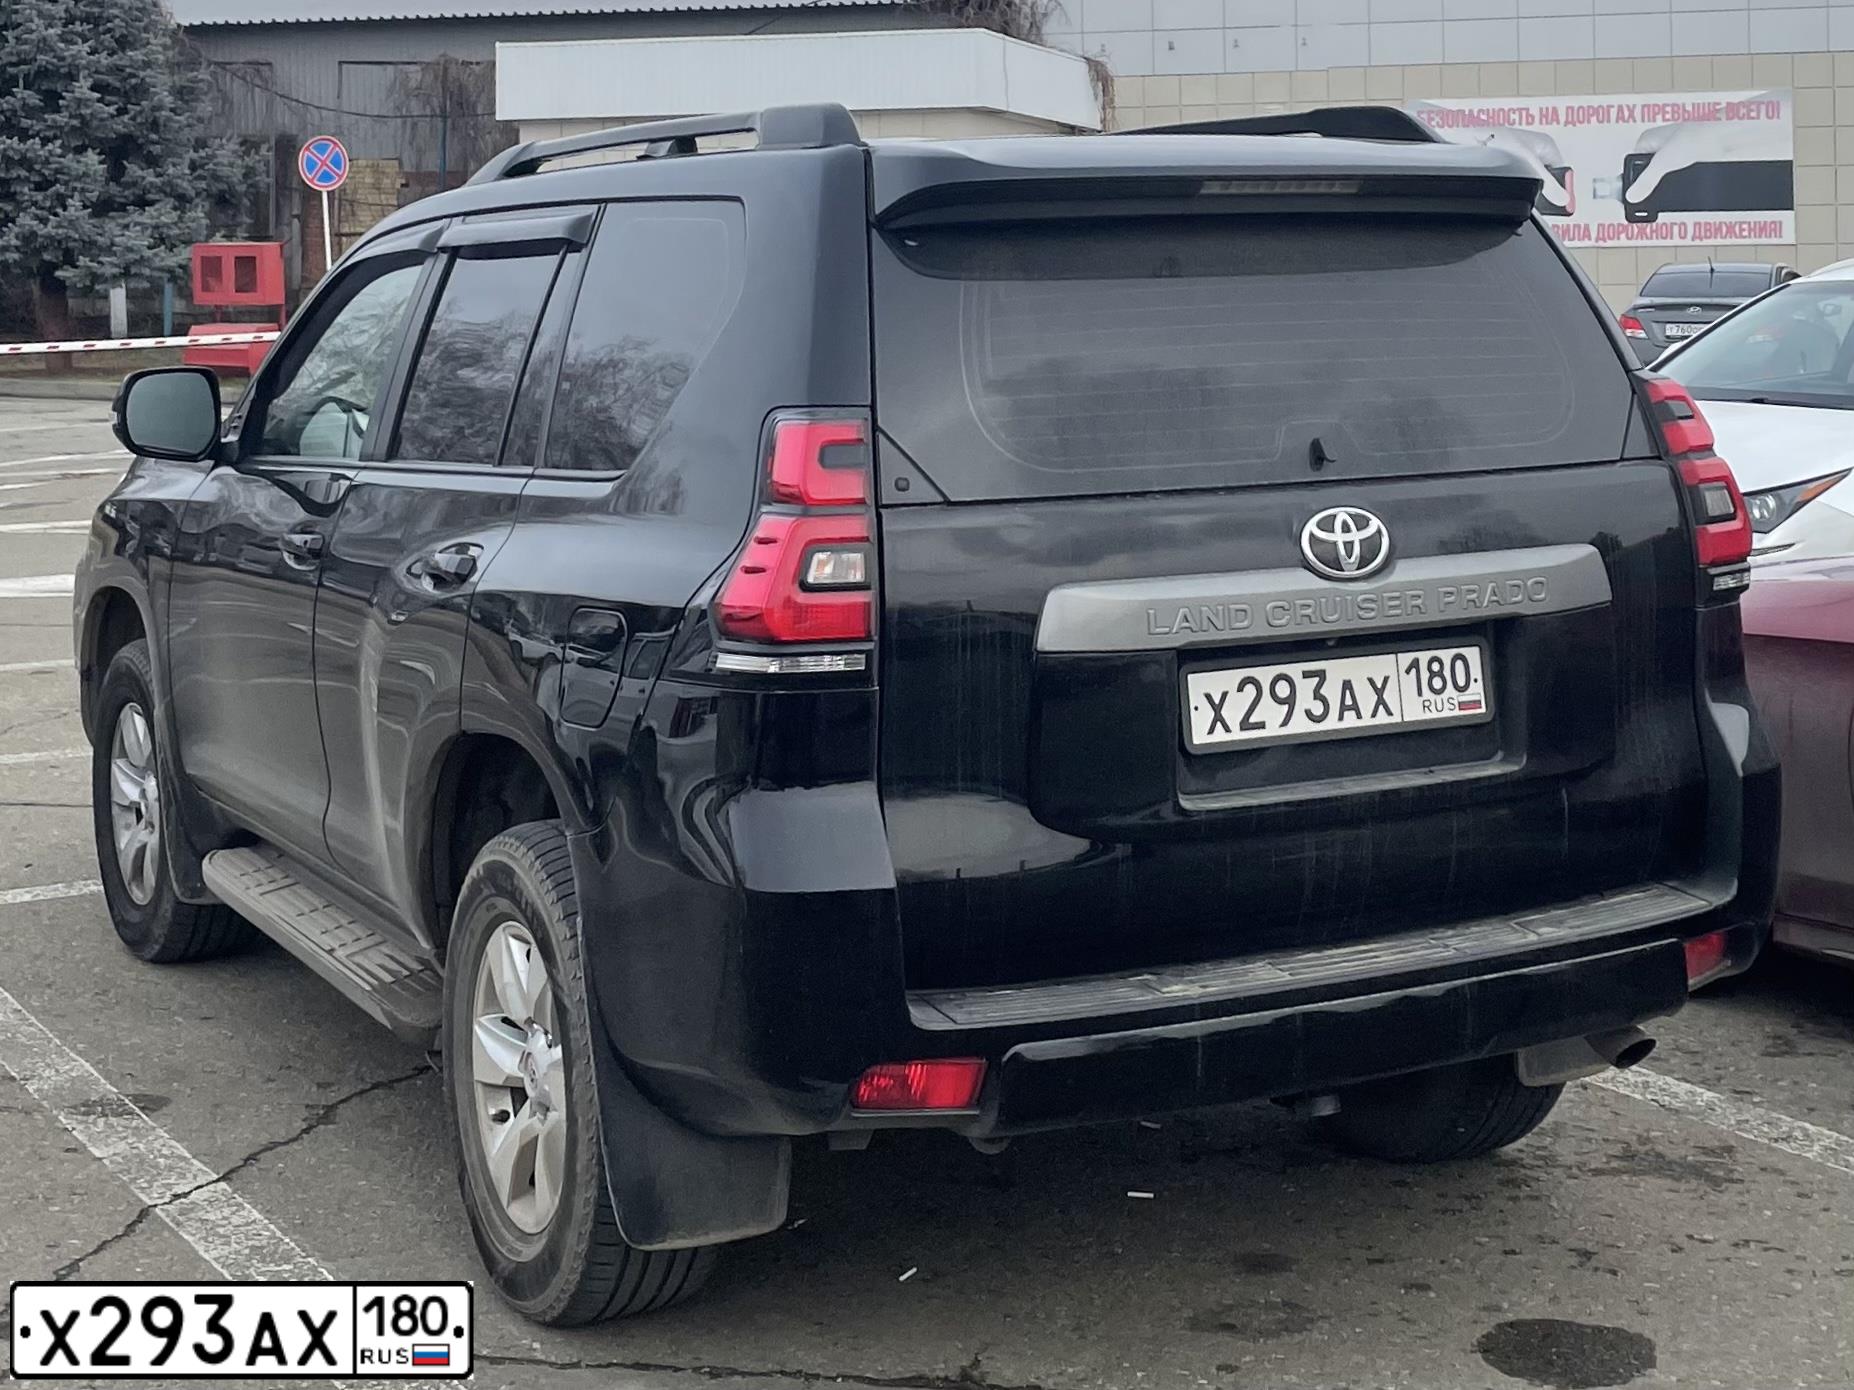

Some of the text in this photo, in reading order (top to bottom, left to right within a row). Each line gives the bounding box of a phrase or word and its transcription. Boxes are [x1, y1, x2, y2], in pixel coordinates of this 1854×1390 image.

[1538, 106, 1560, 125] НА
[1564, 104, 1637, 127] ДОРОГАХ
[1641, 101, 1722, 124] ПРЕВЫШЕ
[1725, 100, 1781, 121] ВСЕГО!
[1551, 220, 1783, 243] ВИЛА ДОРОЖНОГО ДВИЖЕНИЯ!
[1146, 576, 1549, 636] LAND CRUISER PRADO
[1203, 652, 1471, 736] Х293АХ 180
[1422, 696, 1457, 714] RUS
